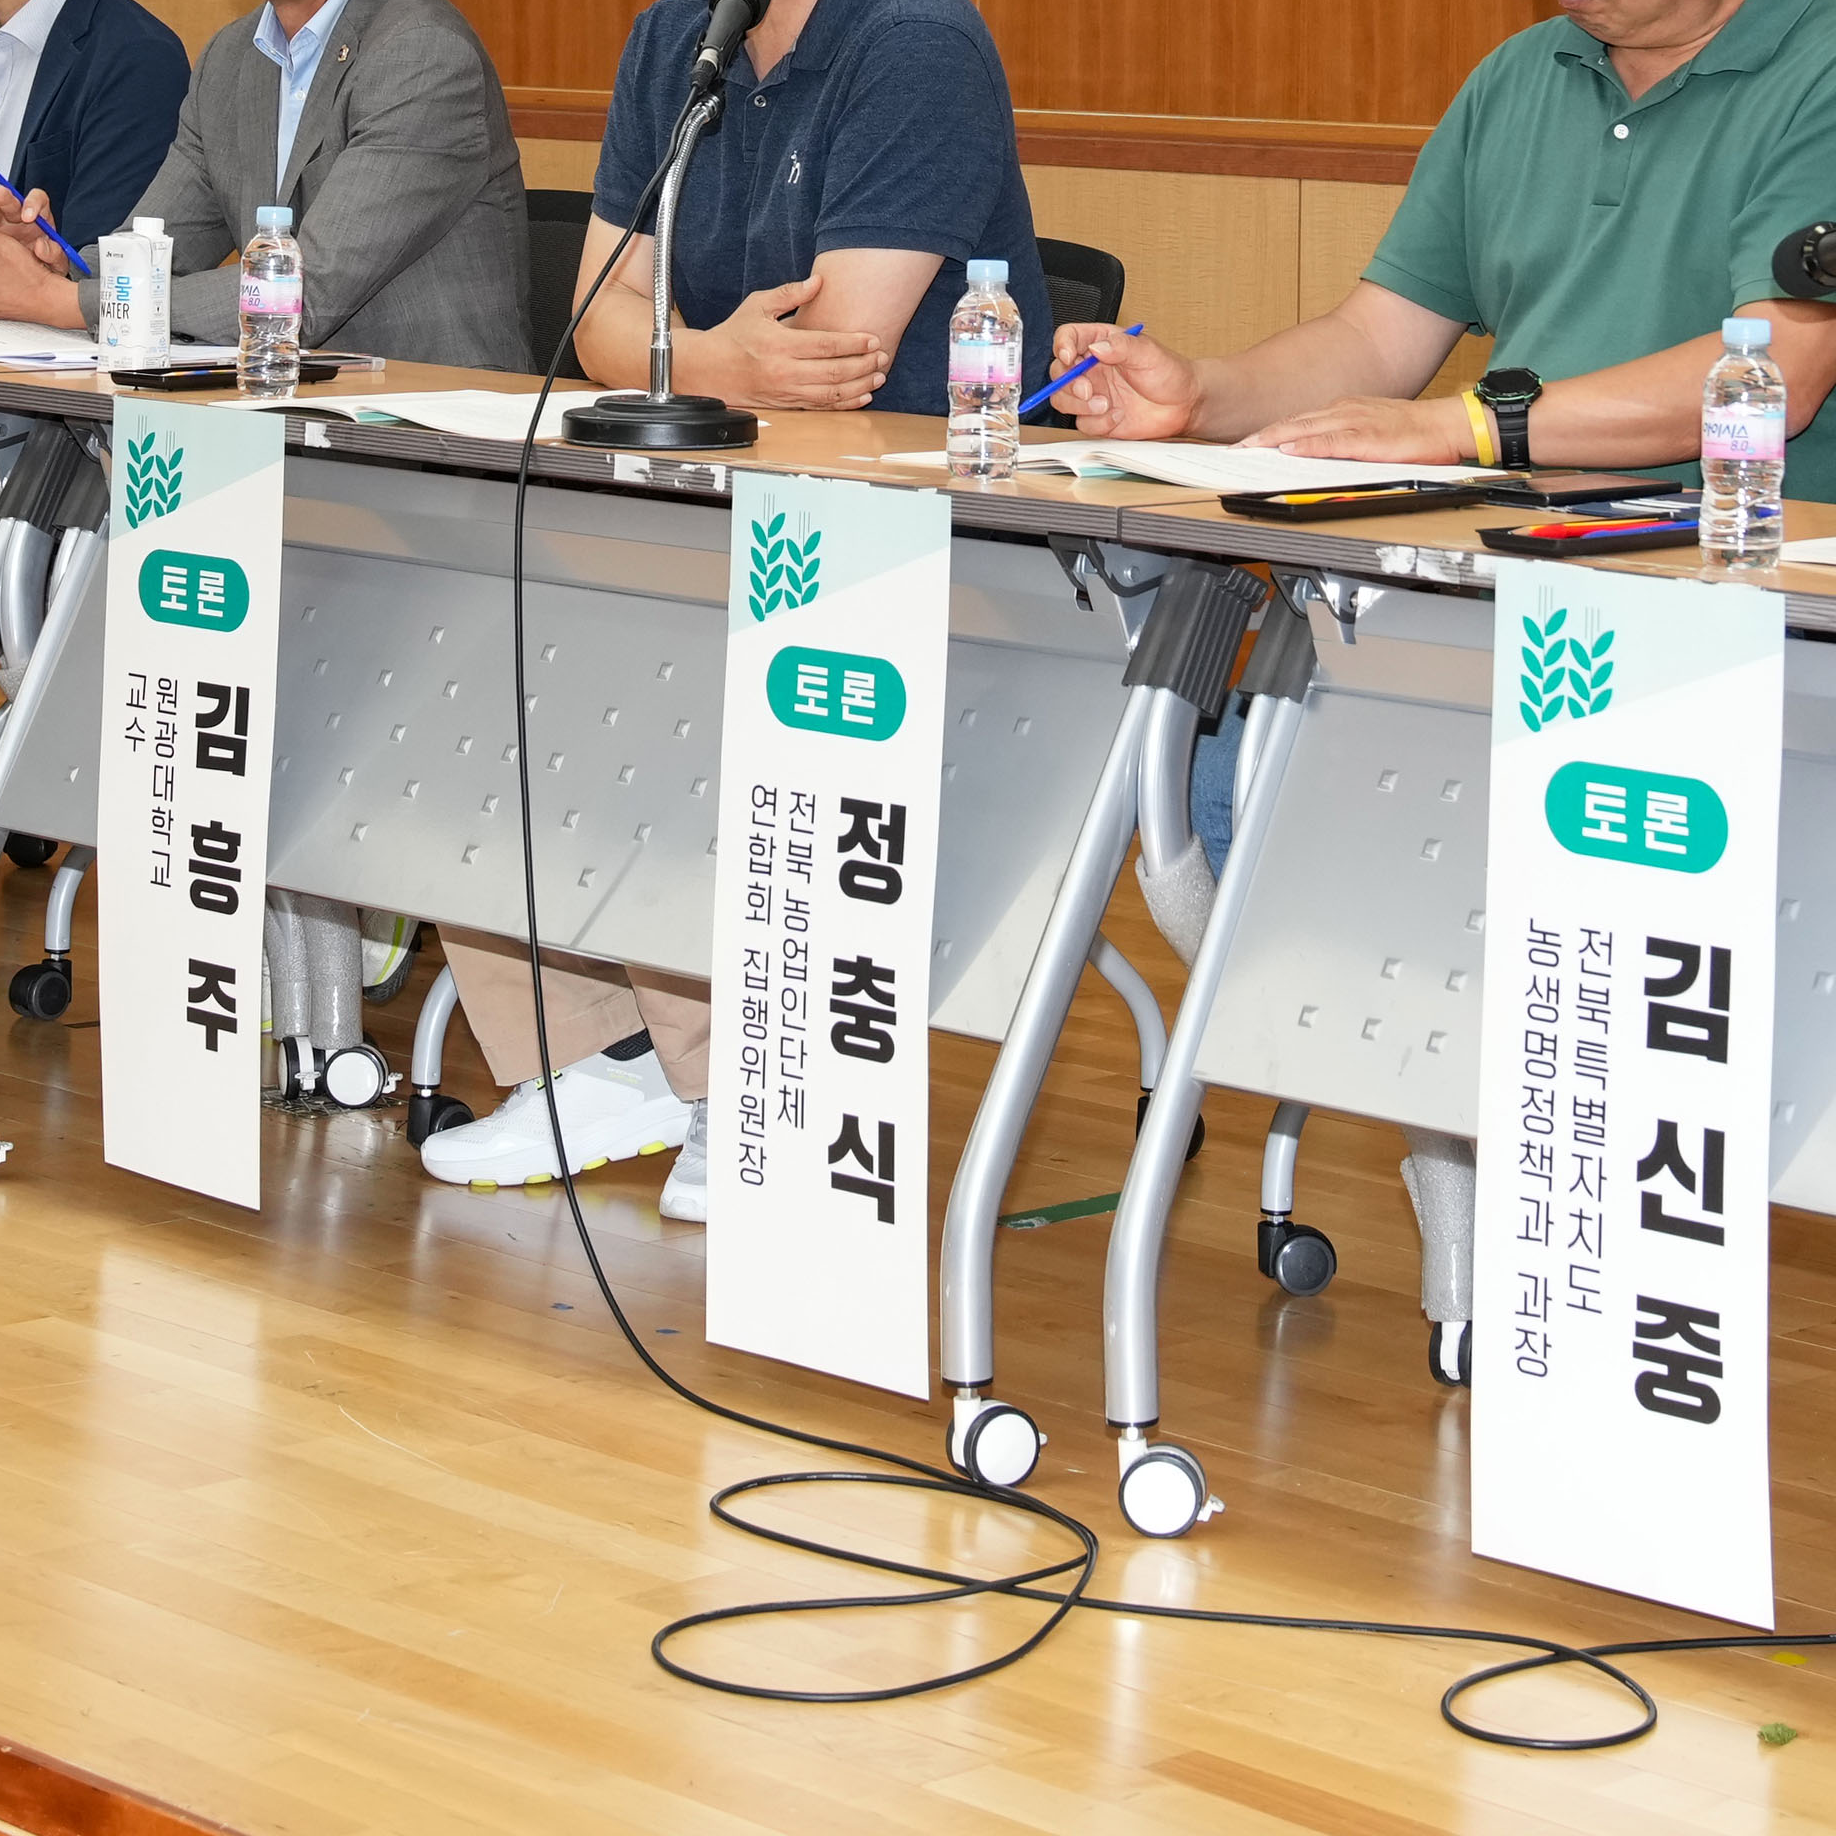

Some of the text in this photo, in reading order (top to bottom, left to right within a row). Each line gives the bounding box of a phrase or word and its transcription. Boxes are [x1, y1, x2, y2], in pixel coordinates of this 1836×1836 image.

[248, 297, 261, 307] 8.0
[1730, 440, 1749, 452] 8.0
[160, 566, 225, 617] 토론
[794, 663, 876, 725] 토론
[125, 673, 147, 752] 교수
[151, 678, 177, 887] 원광대학교
[187, 681, 249, 1052] 김흥주
[1581, 782, 1690, 854] 토론
[739, 785, 777, 1185] 연합회 집행위원장
[828, 797, 906, 1224] 정충식
[1515, 918, 1561, 1377] 농생명정책과 과장
[1567, 929, 1612, 1314] 전북특별자치도
[1633, 936, 1731, 1424] 김신중
